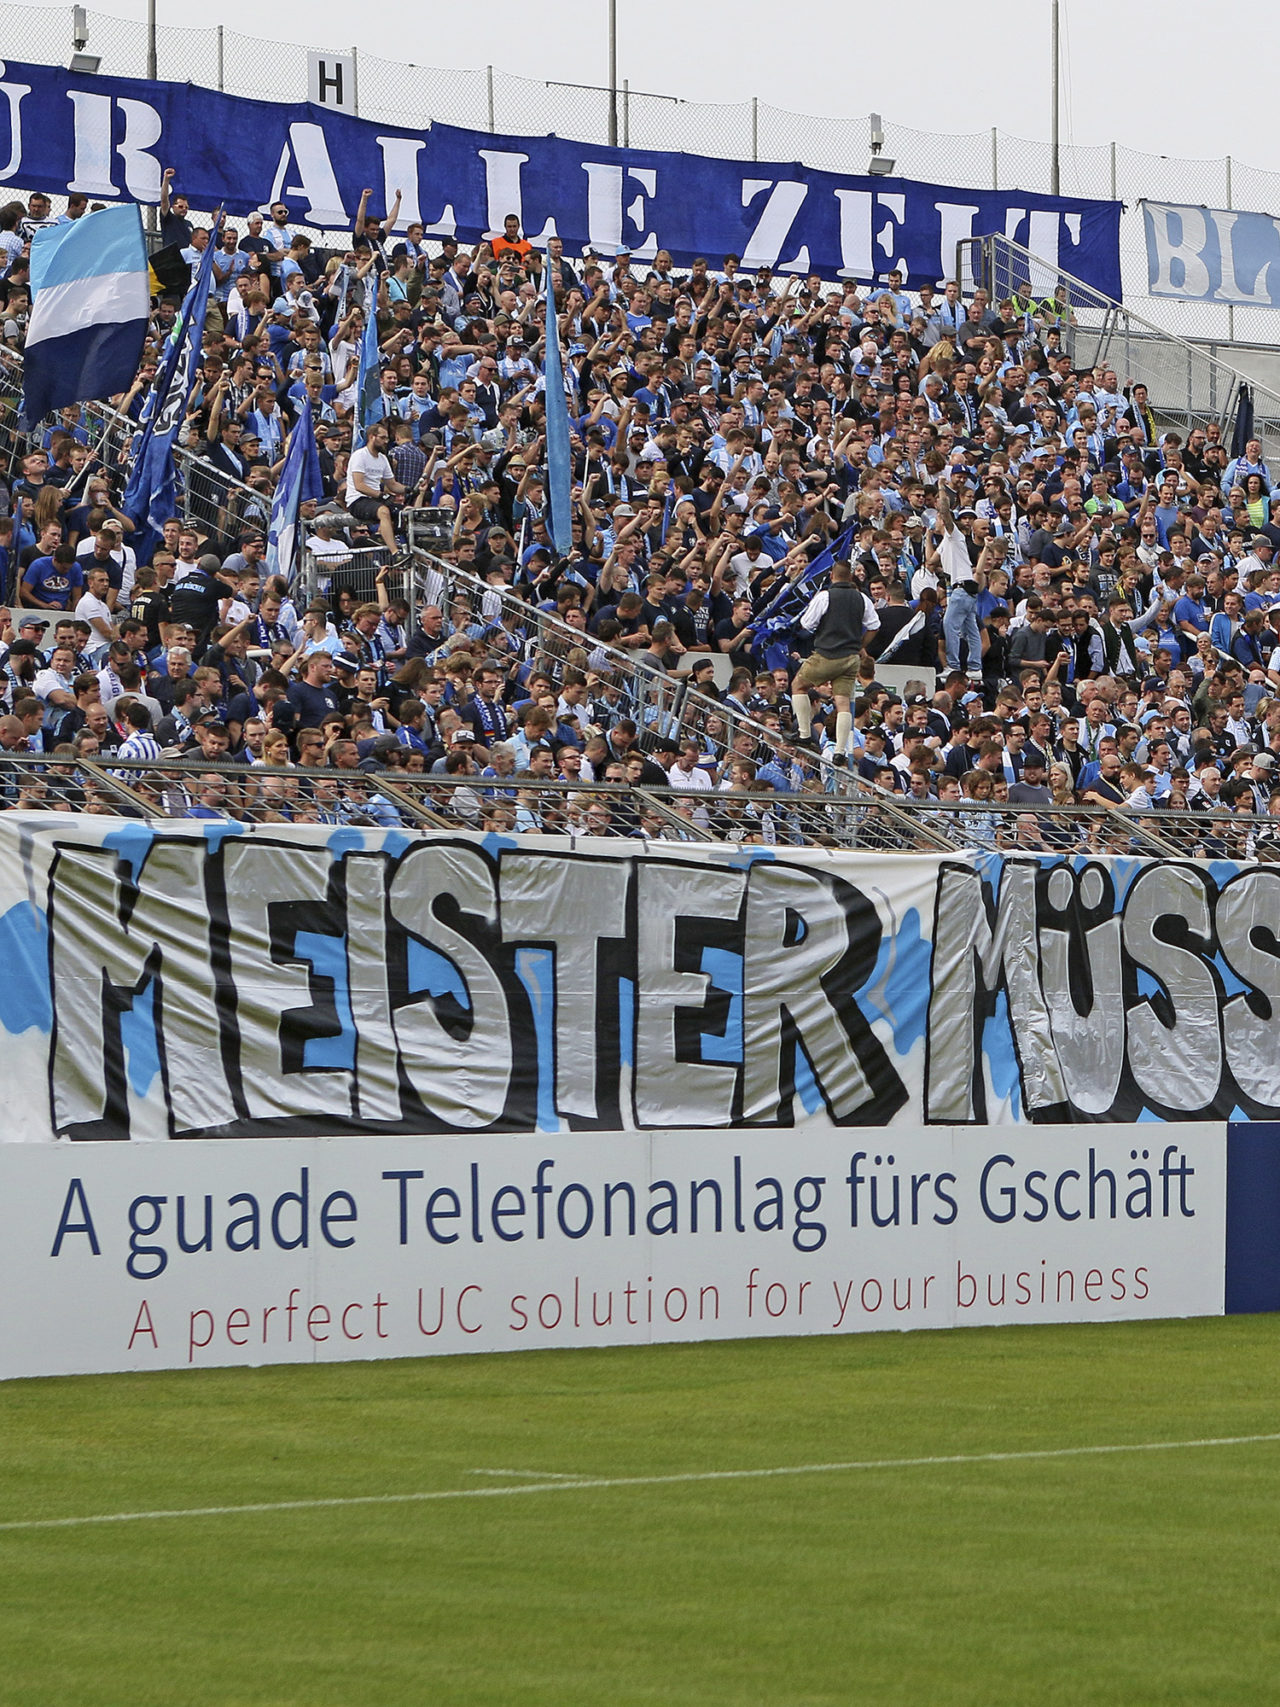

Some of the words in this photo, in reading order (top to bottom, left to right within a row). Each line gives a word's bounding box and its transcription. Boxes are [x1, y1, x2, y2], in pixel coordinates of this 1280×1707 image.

[318, 60, 343, 104] H
[257, 122, 658, 259] ALLE
[740, 179, 1082, 298] ZEIT
[47, 835, 905, 1139] MEISTER
[51, 1179, 101, 1257] A
[127, 1168, 357, 1279] guade
[382, 1156, 826, 1253] Telefonanlag
[846, 1152, 957, 1228] fürs
[980, 1145, 1195, 1224] Gschäft
[128, 1300, 158, 1350] A
[190, 1288, 388, 1362] perfect
[418, 1285, 482, 1336] UC
[510, 1276, 719, 1332] solution
[745, 1269, 812, 1320] for
[833, 1270, 936, 1326] your
[957, 1260, 1149, 1307] business
